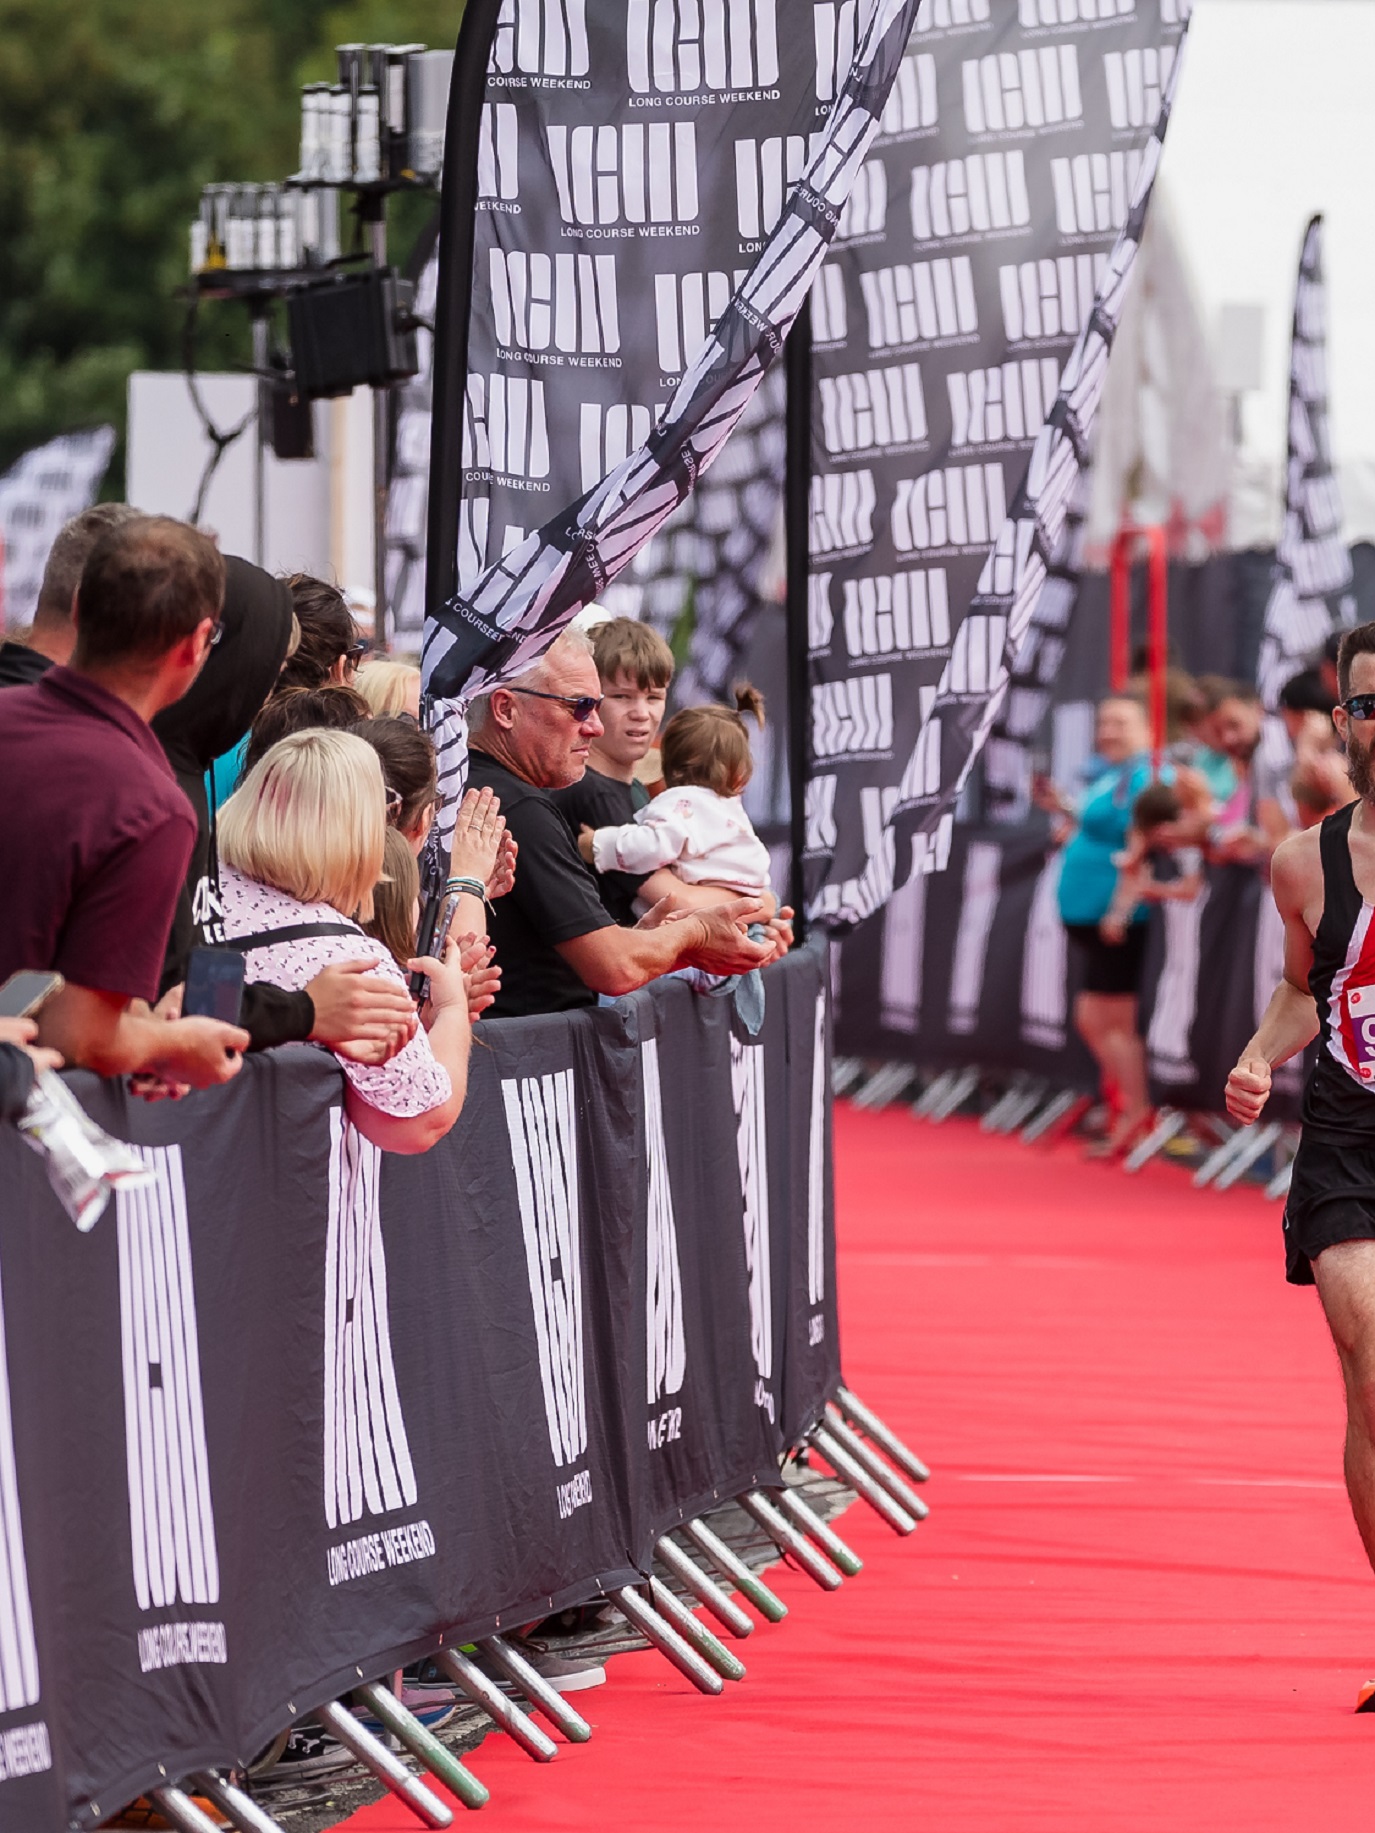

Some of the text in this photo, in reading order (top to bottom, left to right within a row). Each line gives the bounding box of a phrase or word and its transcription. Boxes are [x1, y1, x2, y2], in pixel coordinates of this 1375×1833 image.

[530, 77, 591, 90] WEEKEND
[628, 89, 781, 108] LONG COURSE WEEKEND
[560, 225, 701, 239] LONG COURSE WEEKEND
[496, 347, 522, 361] LONG
[567, 356, 623, 368] WEEKEND
[496, 476, 551, 492] WEEKEND
[346, 1533, 386, 1579] COURSE
[380, 1520, 436, 1568] WEEKEND
